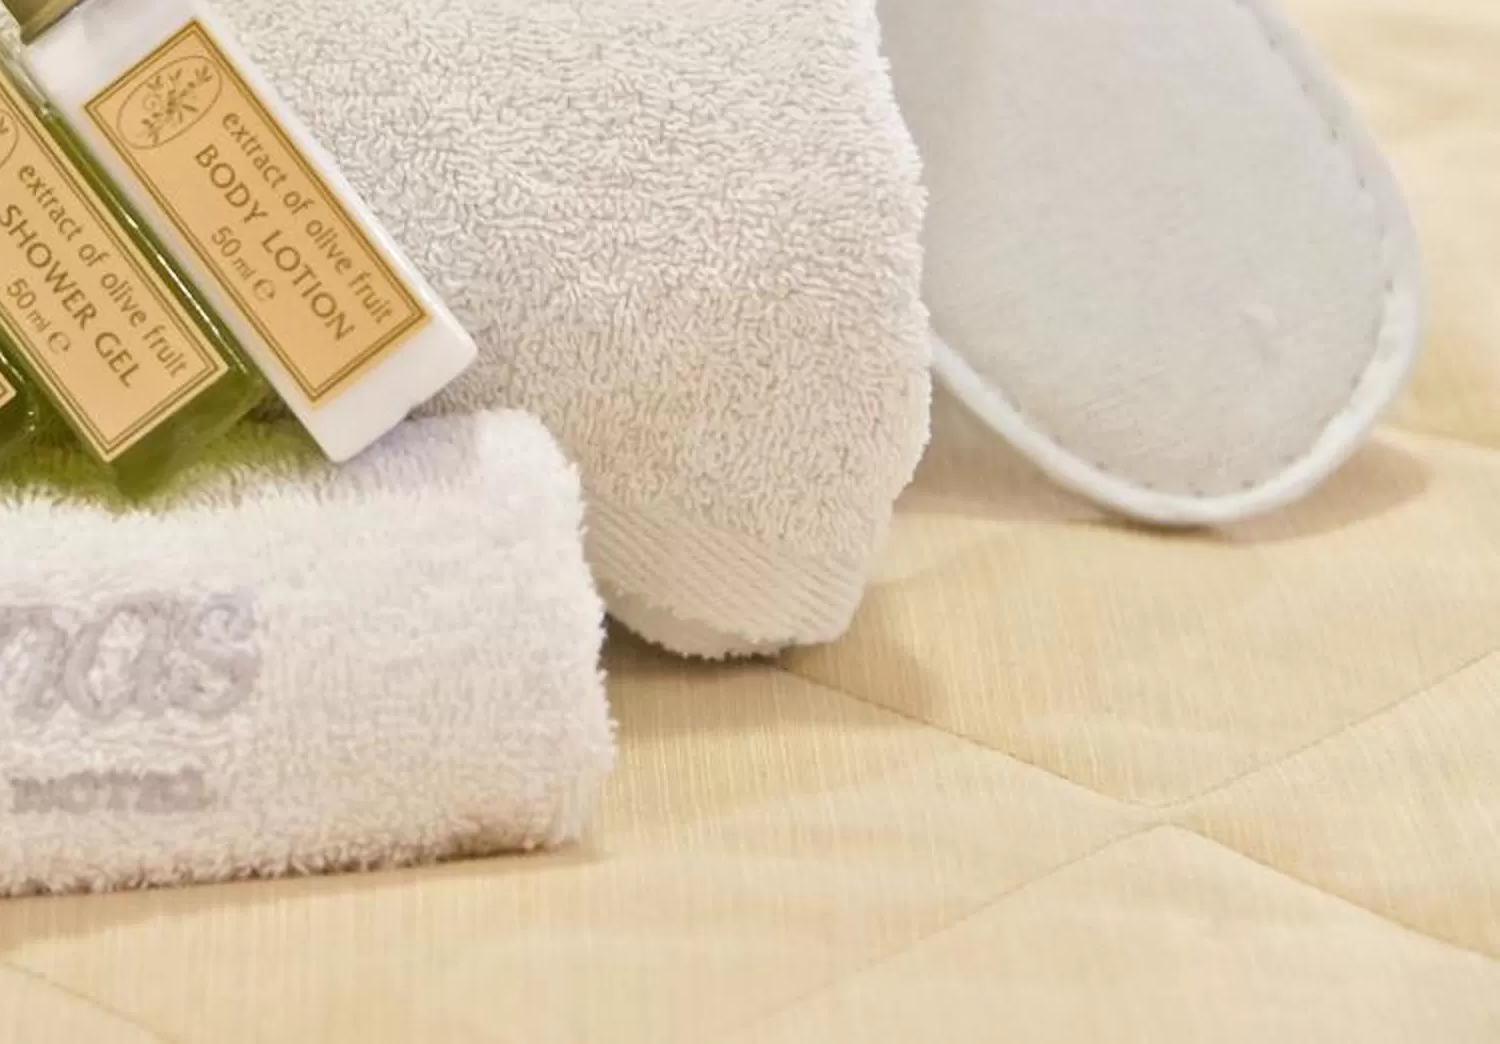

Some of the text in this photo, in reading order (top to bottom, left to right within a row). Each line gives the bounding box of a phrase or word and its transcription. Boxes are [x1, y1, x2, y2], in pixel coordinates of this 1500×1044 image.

[17, 163, 190, 380] extract of olive fruit
[194, 143, 357, 341] BODY LOTION
[222, 111, 397, 326] extract of olive fruit
[93, 330, 143, 390] GEL
